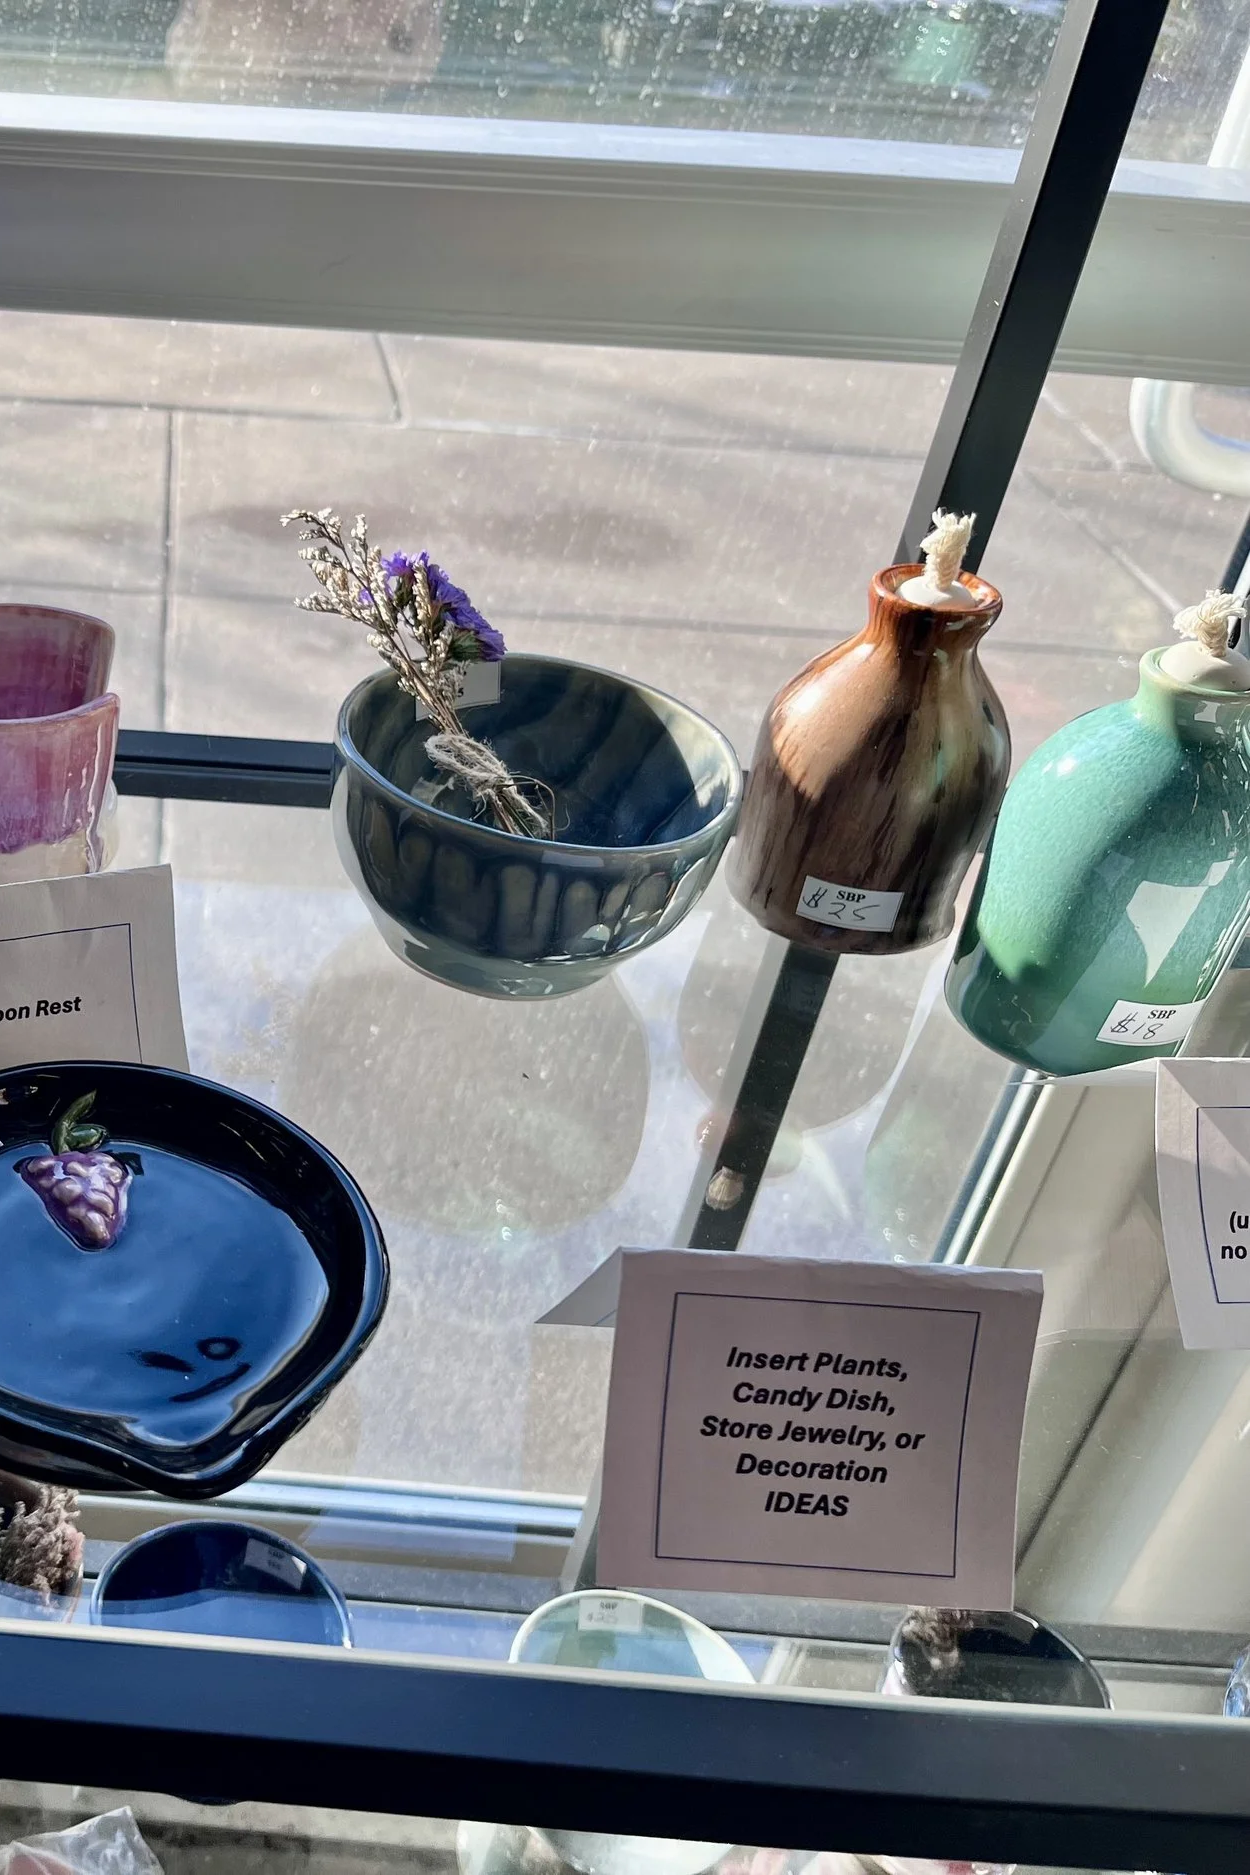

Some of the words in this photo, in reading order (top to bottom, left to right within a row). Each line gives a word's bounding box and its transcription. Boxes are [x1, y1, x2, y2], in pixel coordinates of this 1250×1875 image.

[836, 890, 866, 903] SBP
[36, 996, 82, 1017] Rest
[1147, 1009, 1177, 1019] SBP
[1221, 1245, 1247, 1260] no
[726, 1346, 809, 1372] Insert
[813, 1352, 908, 1382] Plants,
[732, 1381, 822, 1412] Candy
[826, 1387, 895, 1416] Dish,
[700, 1415, 773, 1440] Store
[778, 1420, 886, 1451] Jewelry,
[895, 1431, 926, 1450] or
[735, 1453, 888, 1483] Decoration
[764, 1491, 850, 1517] IDEAS
